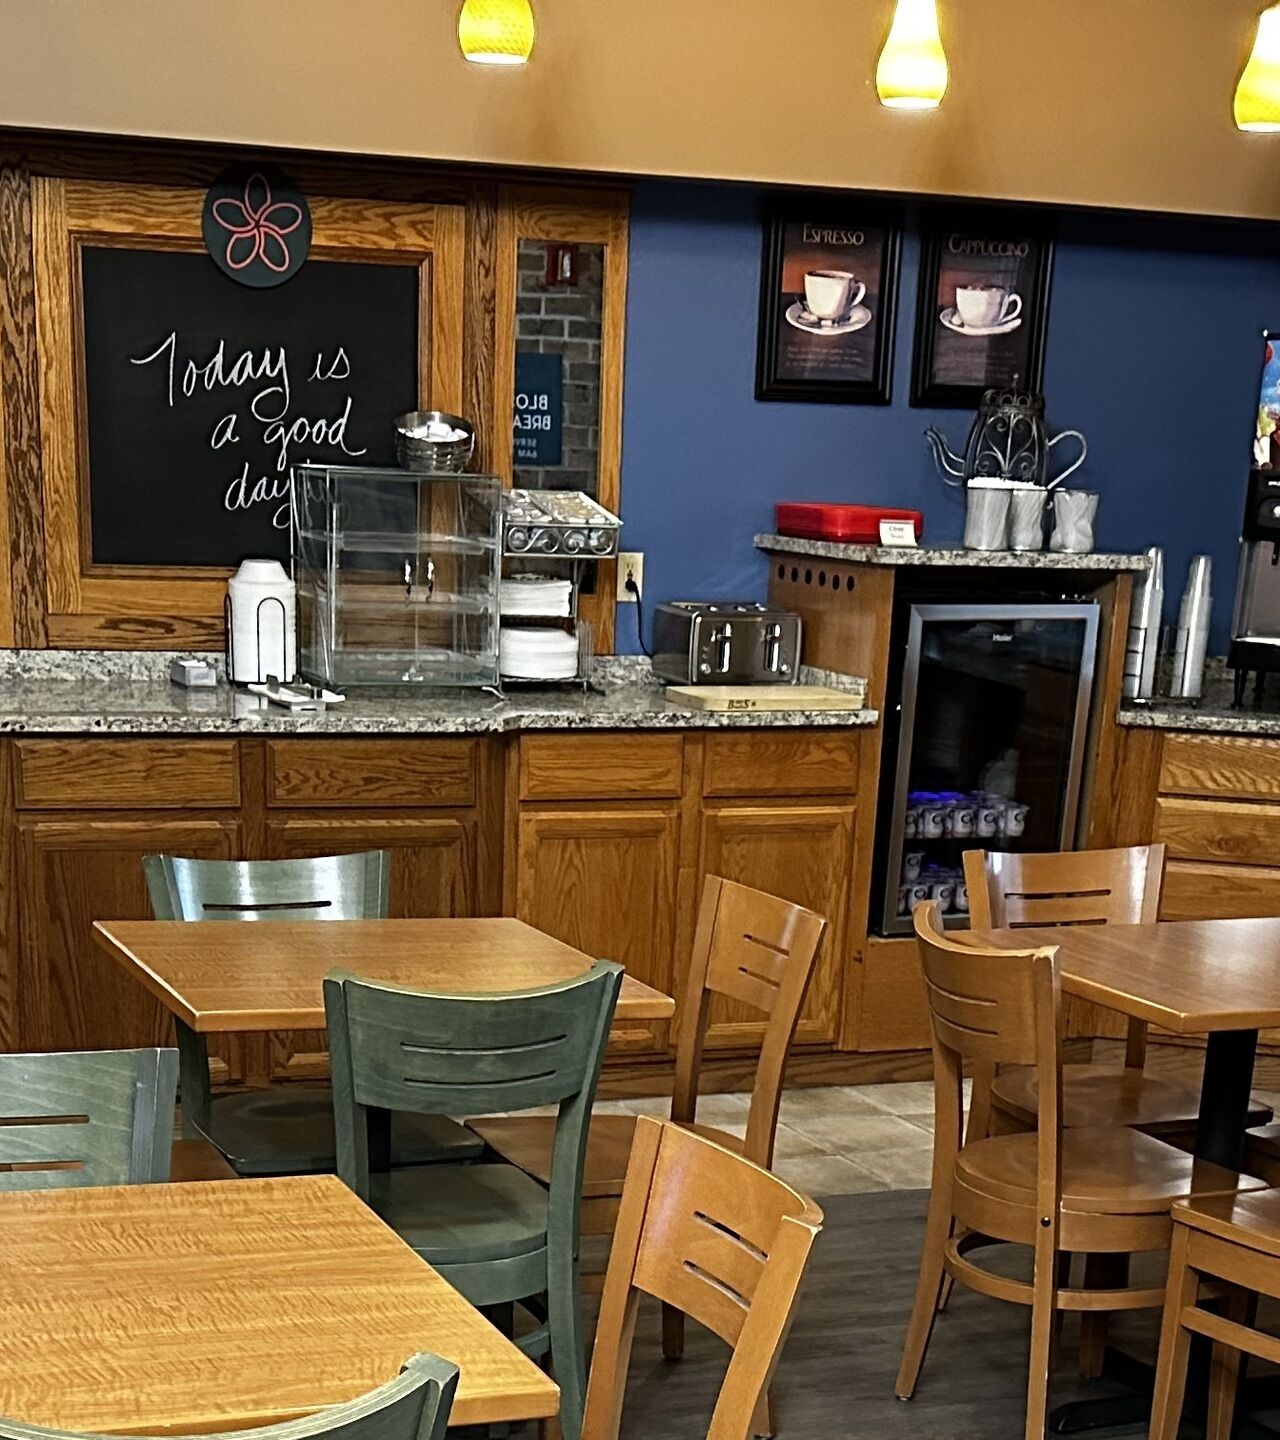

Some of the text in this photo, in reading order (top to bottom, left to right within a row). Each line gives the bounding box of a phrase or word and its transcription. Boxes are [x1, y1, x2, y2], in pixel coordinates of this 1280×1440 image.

[802, 222, 865, 246] ESPRESSO
[130, 331, 350, 422] Today is
[211, 396, 367, 472] a good
